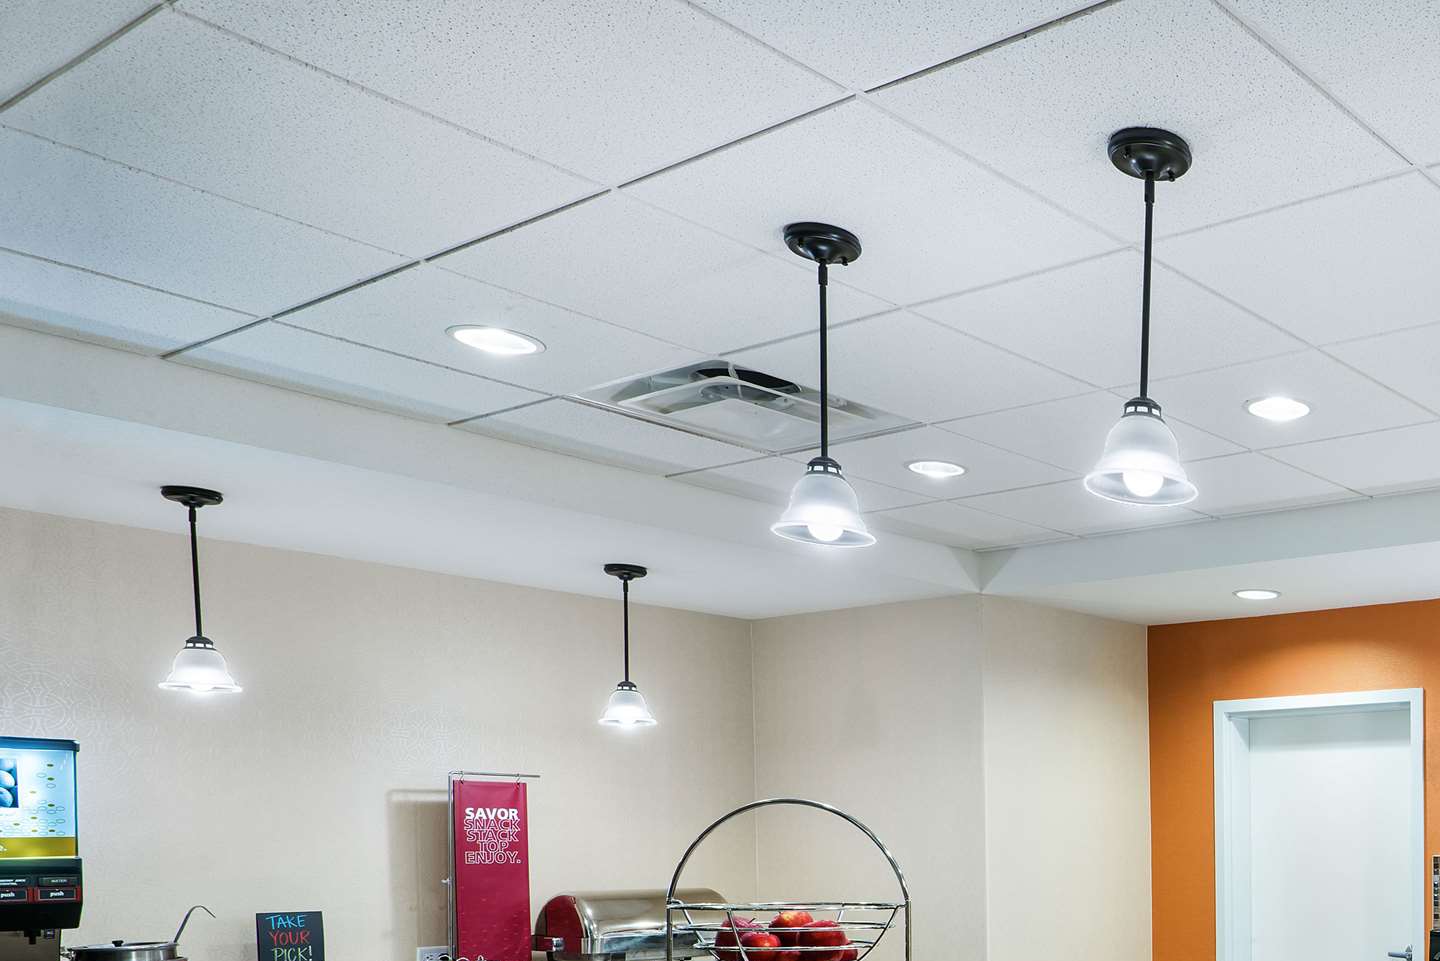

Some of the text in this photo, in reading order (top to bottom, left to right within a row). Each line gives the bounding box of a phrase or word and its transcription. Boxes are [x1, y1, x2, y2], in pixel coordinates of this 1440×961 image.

[464, 807, 518, 820] SAVOR
[463, 818, 520, 831] SNACK
[466, 829, 519, 842] STACK
[477, 840, 508, 852] TOP
[464, 851, 521, 864] ENJOY.
[265, 914, 311, 930] TAKE
[268, 929, 310, 946] YOUR
